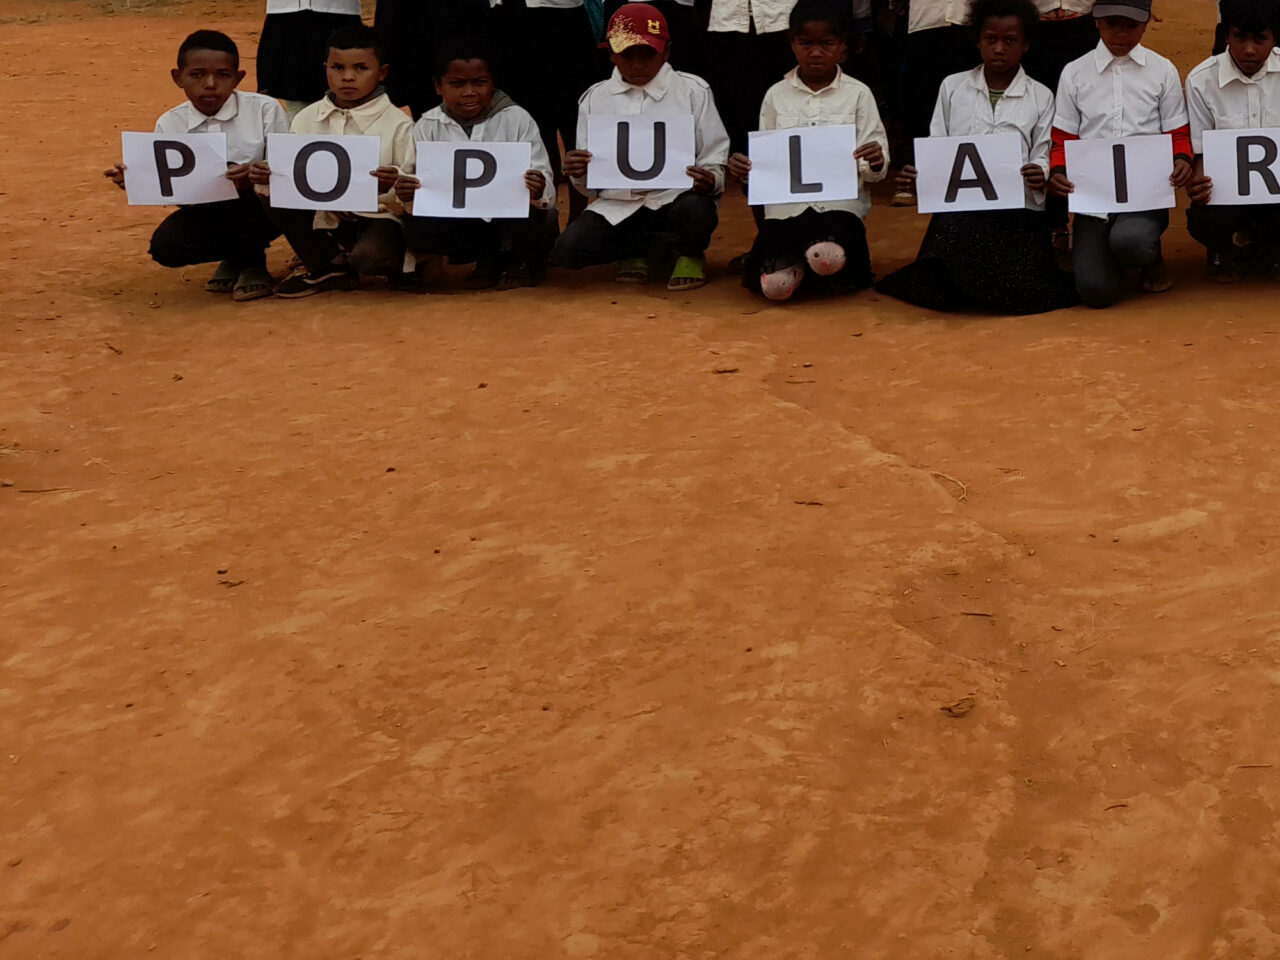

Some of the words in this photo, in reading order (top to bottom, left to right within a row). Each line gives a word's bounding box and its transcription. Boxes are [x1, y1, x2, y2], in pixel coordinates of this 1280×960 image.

[152, 139, 196, 198] P
[292, 140, 352, 203] O
[452, 148, 498, 209] P
[616, 121, 667, 181] U
[788, 134, 823, 194] L
[944, 142, 999, 204] A
